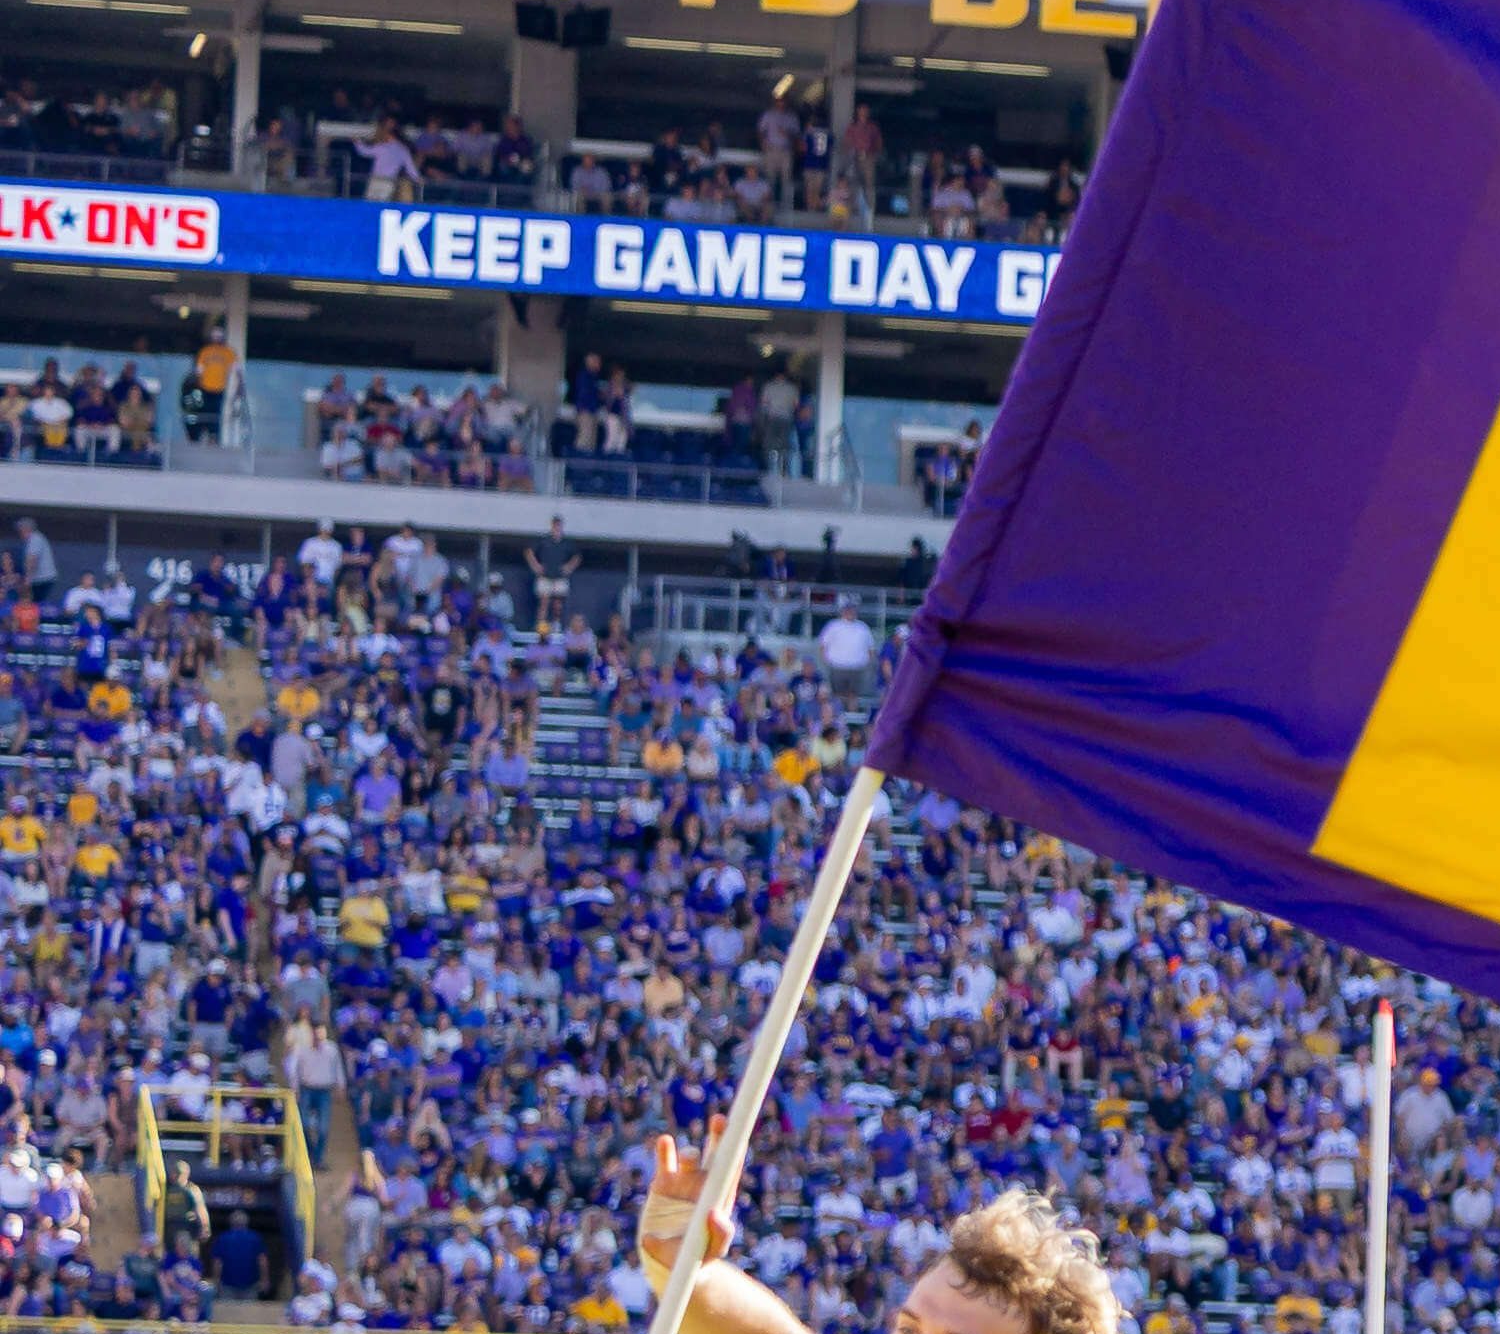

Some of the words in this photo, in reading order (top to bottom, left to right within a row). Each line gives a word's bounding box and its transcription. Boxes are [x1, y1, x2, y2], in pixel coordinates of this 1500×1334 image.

[377, 207, 571, 285] KEEP
[593, 223, 808, 302] GAME
[829, 238, 976, 313] DAY
